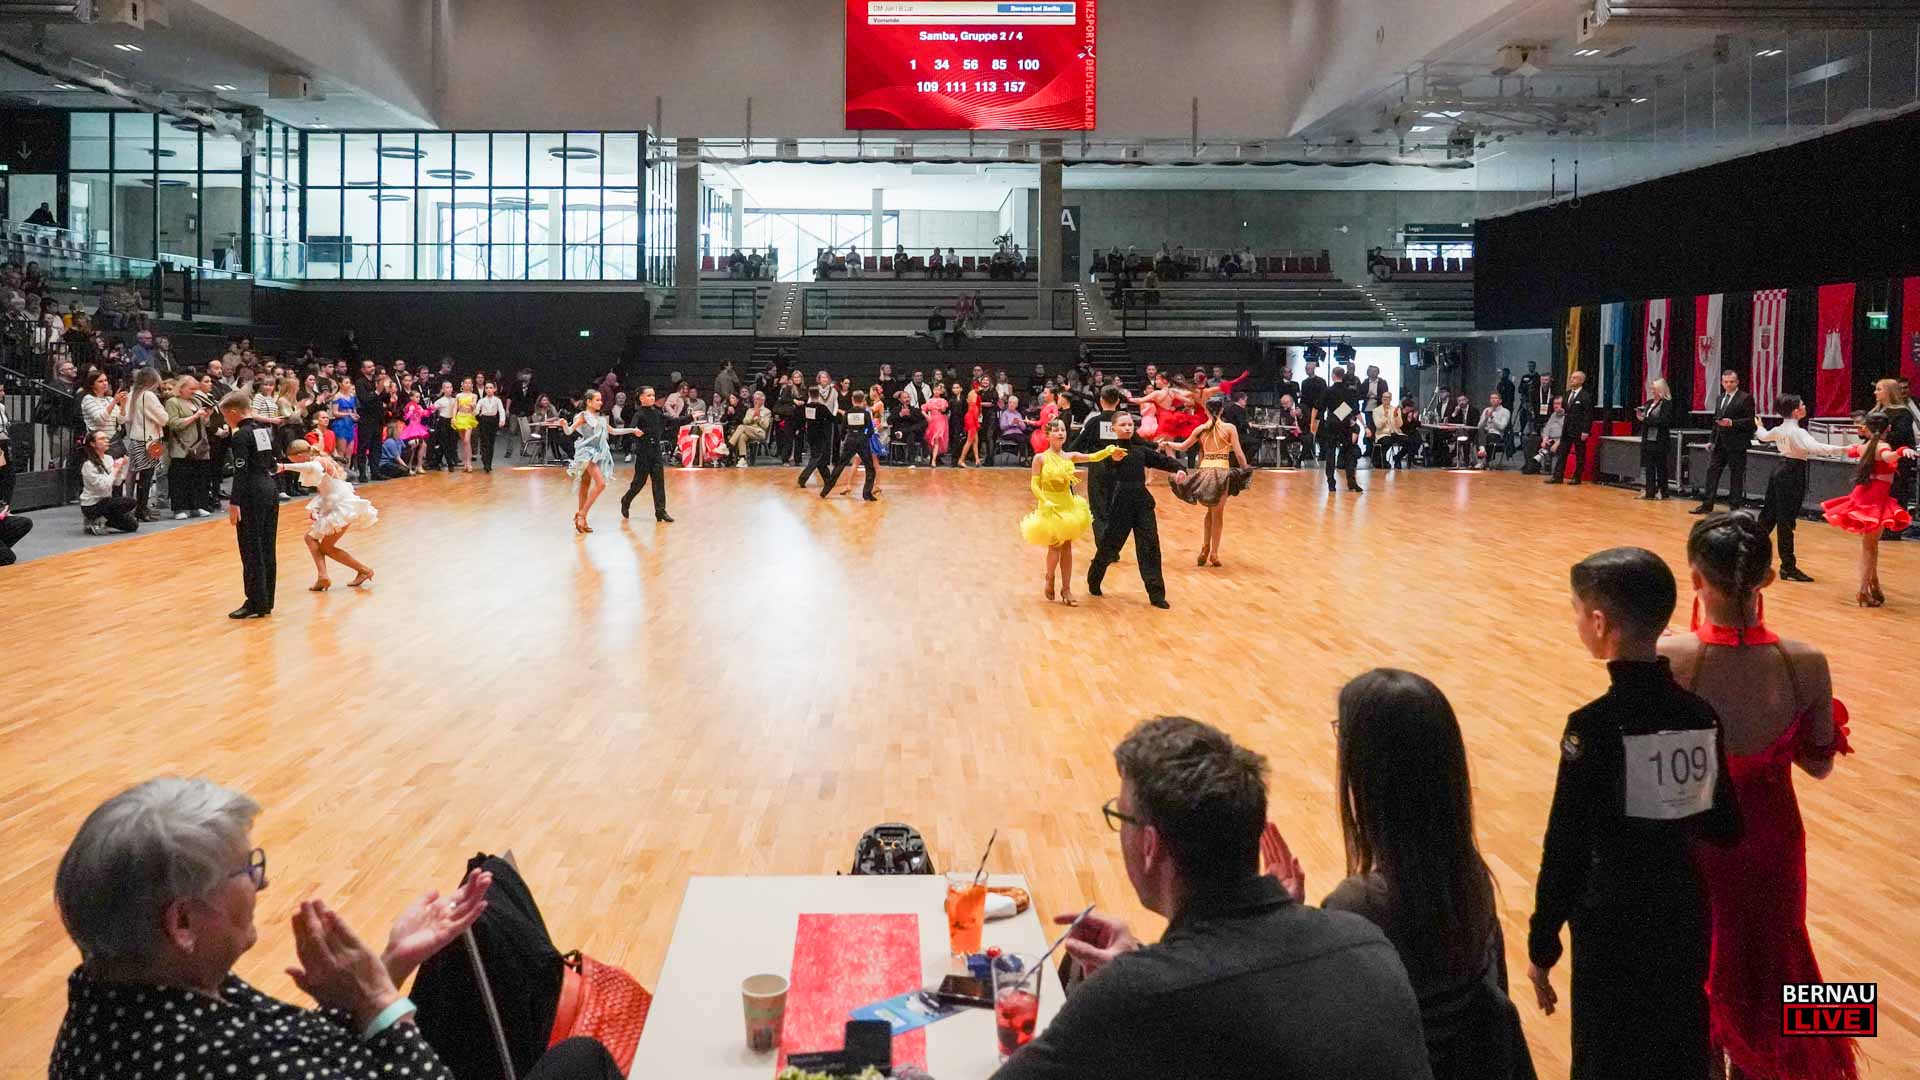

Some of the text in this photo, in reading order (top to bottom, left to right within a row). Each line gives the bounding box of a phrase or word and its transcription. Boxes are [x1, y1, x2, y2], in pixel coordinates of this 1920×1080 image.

[919, 31, 1024, 42] Samba, Gruppe 2 / 4
[909, 59, 1040, 70] 1 34 56 85 100
[916, 81, 1026, 92] 109 111 113 157
[1085, 58, 1095, 130] DEUTSCHLAND
[1061, 208, 1077, 232] A
[1648, 746, 1707, 785] 109
